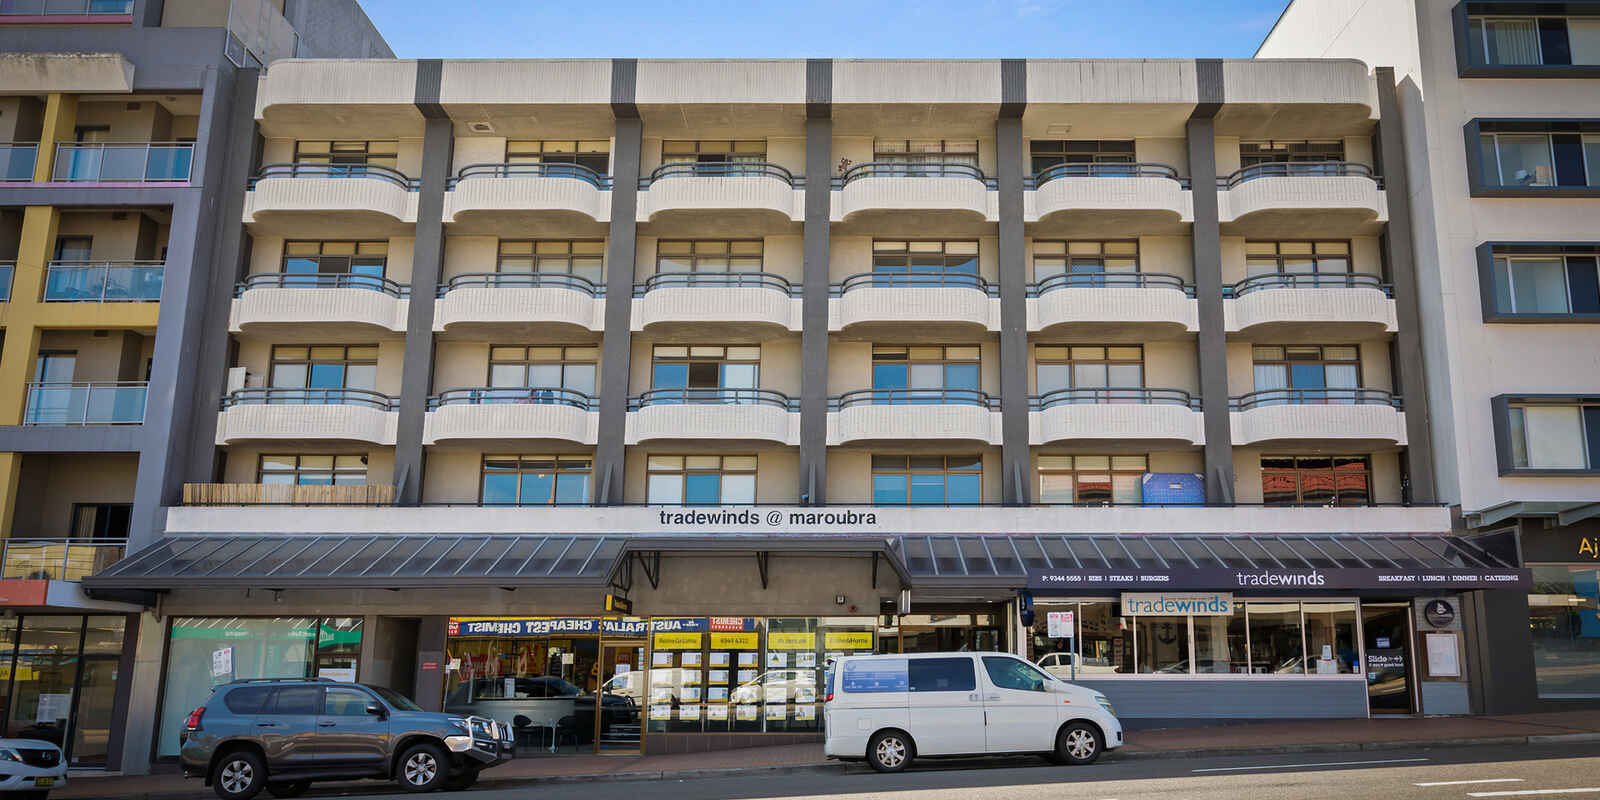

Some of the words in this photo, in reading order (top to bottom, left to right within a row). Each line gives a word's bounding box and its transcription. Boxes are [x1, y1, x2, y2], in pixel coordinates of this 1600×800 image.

[659, 510, 760, 525] tradewinds
[766, 510, 783, 526] @
[789, 510, 877, 525] maroubra
[1236, 570, 1325, 586] tradewinds
[1128, 595, 1229, 614] tradewinds
